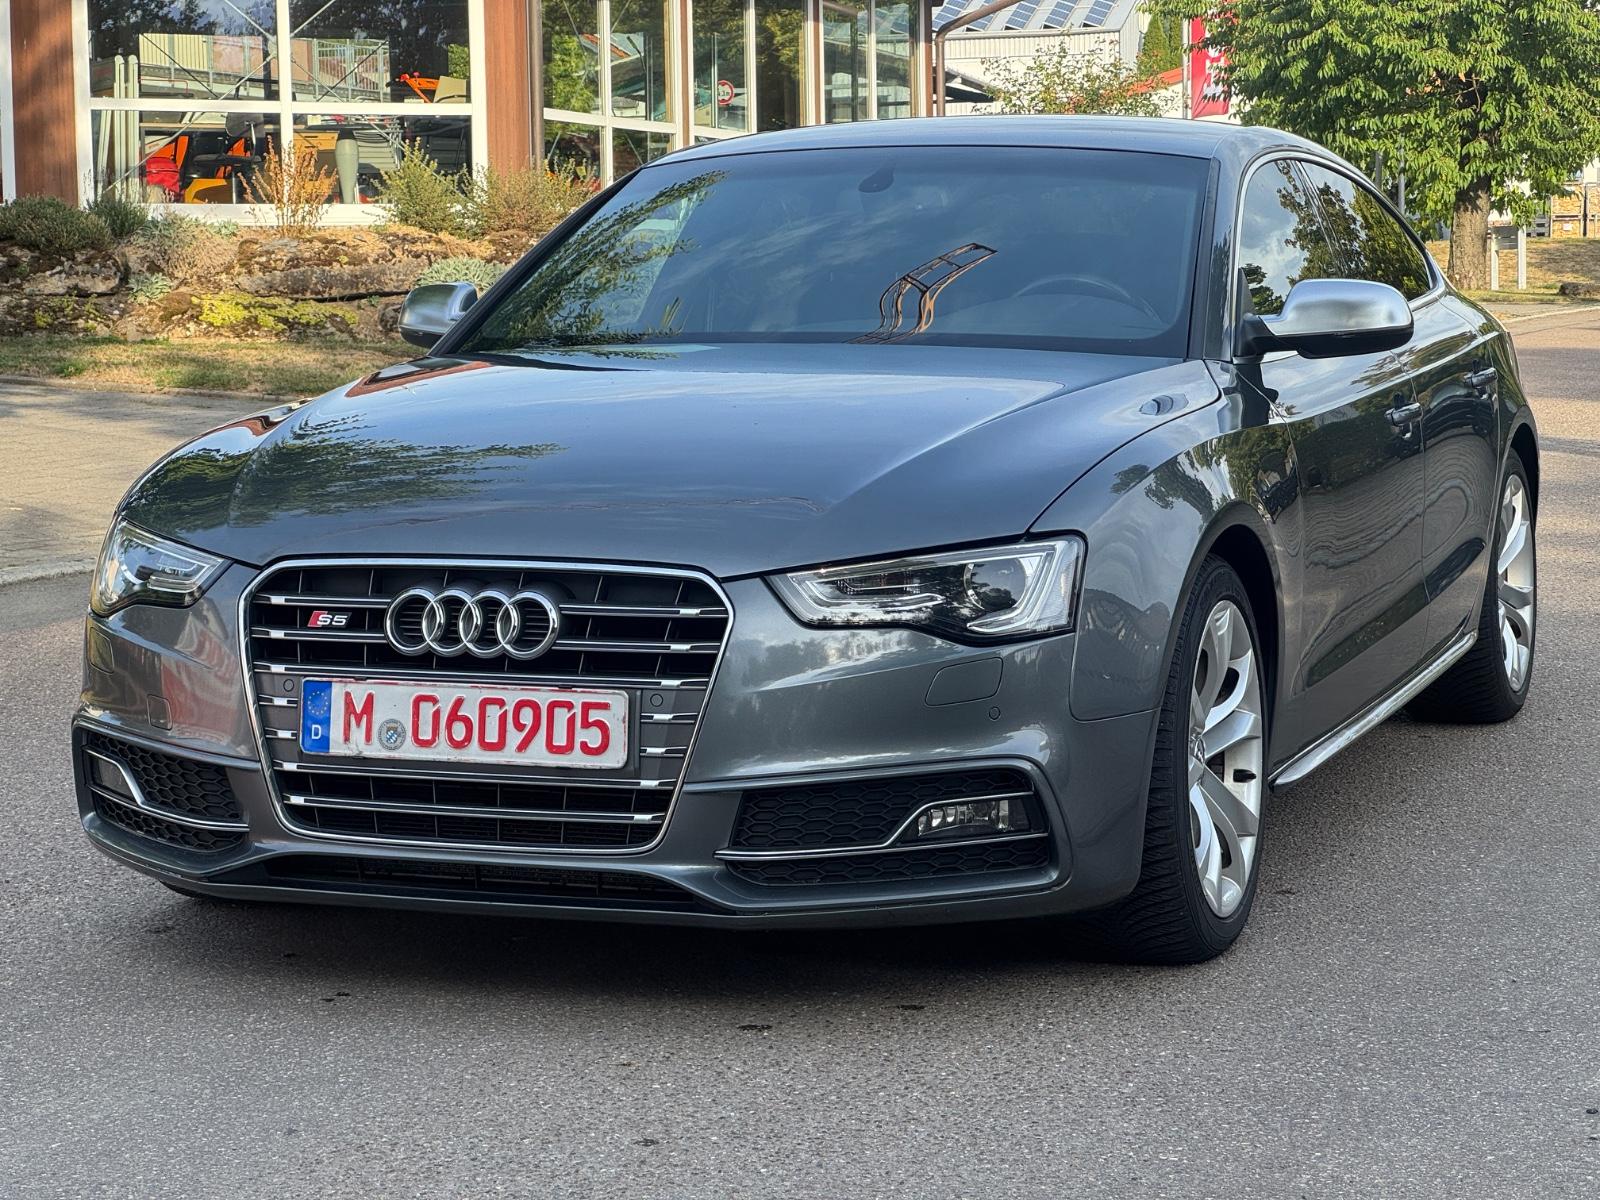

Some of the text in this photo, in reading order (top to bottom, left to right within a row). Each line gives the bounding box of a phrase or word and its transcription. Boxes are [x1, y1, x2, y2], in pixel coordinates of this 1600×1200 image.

[316, 614, 348, 626] S5
[343, 690, 374, 745] M
[411, 694, 611, 756] 060905
[311, 724, 322, 740] D
